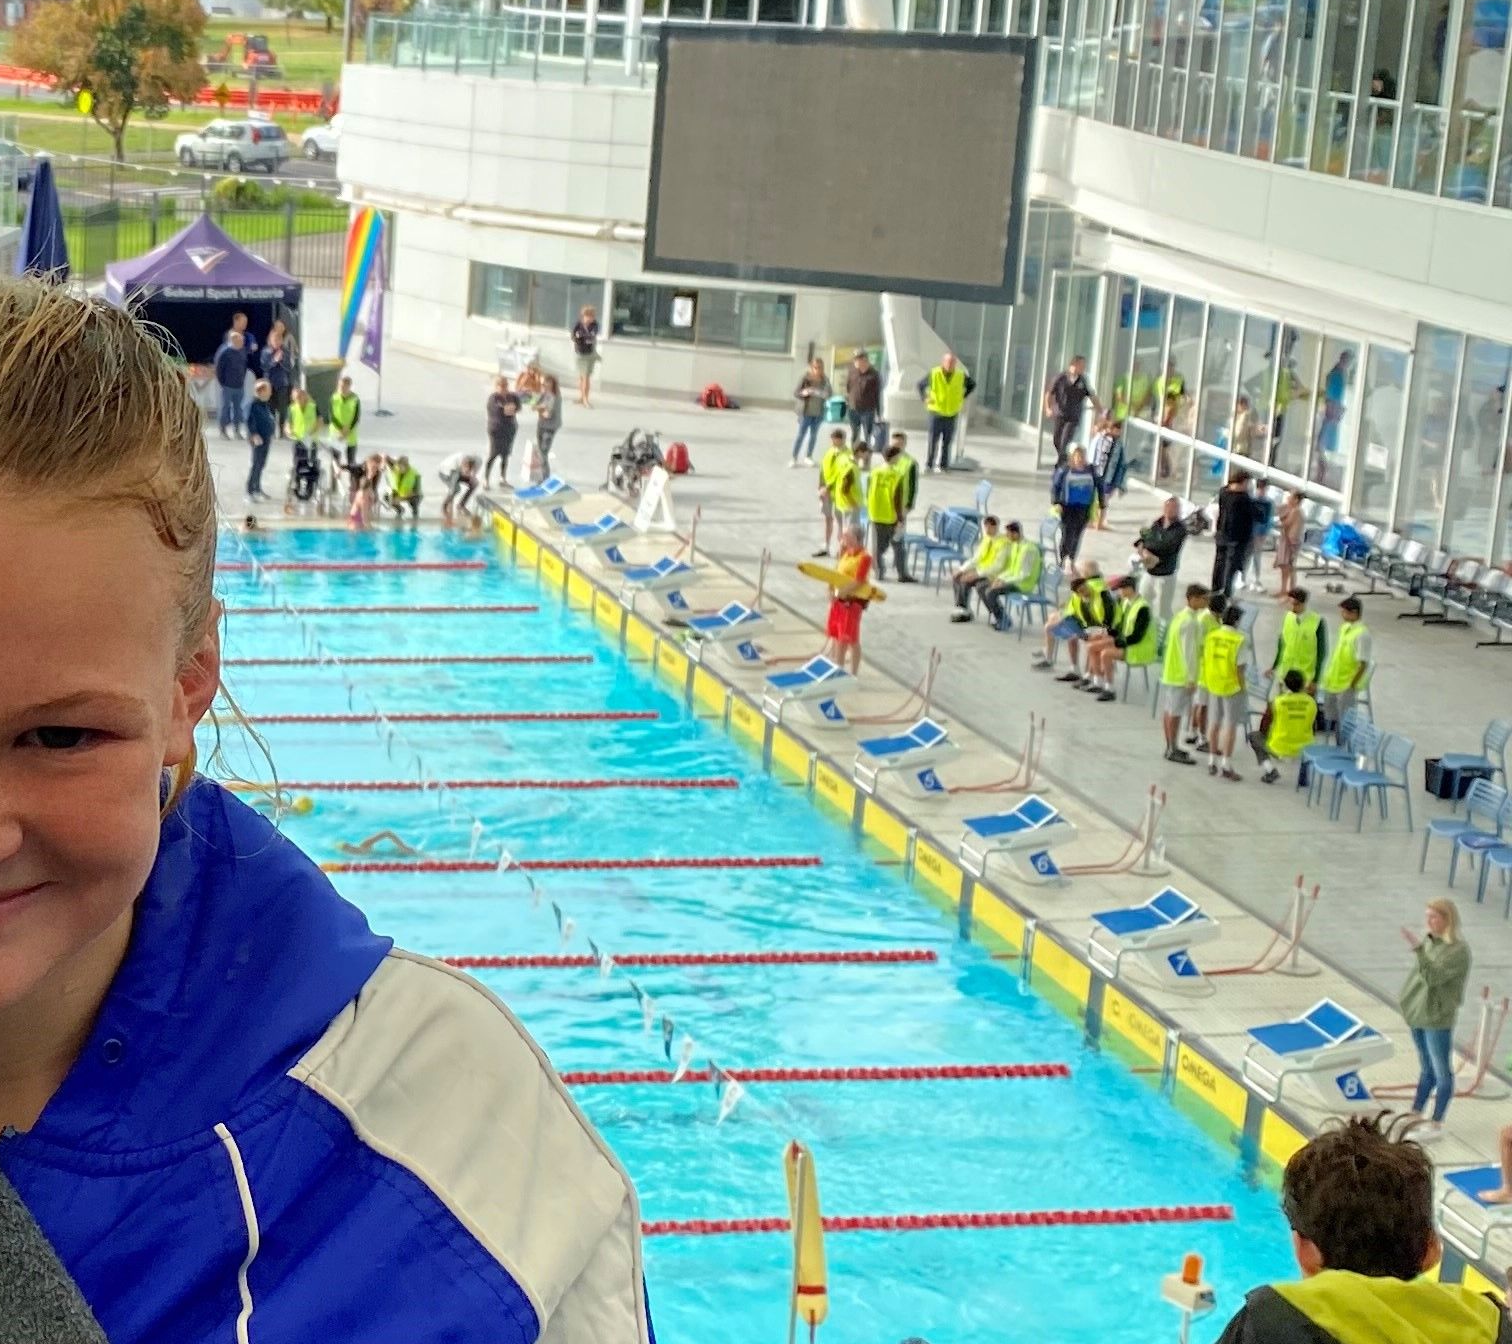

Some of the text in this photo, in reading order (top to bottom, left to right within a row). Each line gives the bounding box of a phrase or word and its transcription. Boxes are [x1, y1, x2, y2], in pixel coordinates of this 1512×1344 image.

[1036, 855, 1049, 872] 6
[1175, 955, 1189, 973] 7
[1181, 1054, 1217, 1094] OMEGA
[1344, 1076, 1359, 1097] 8
